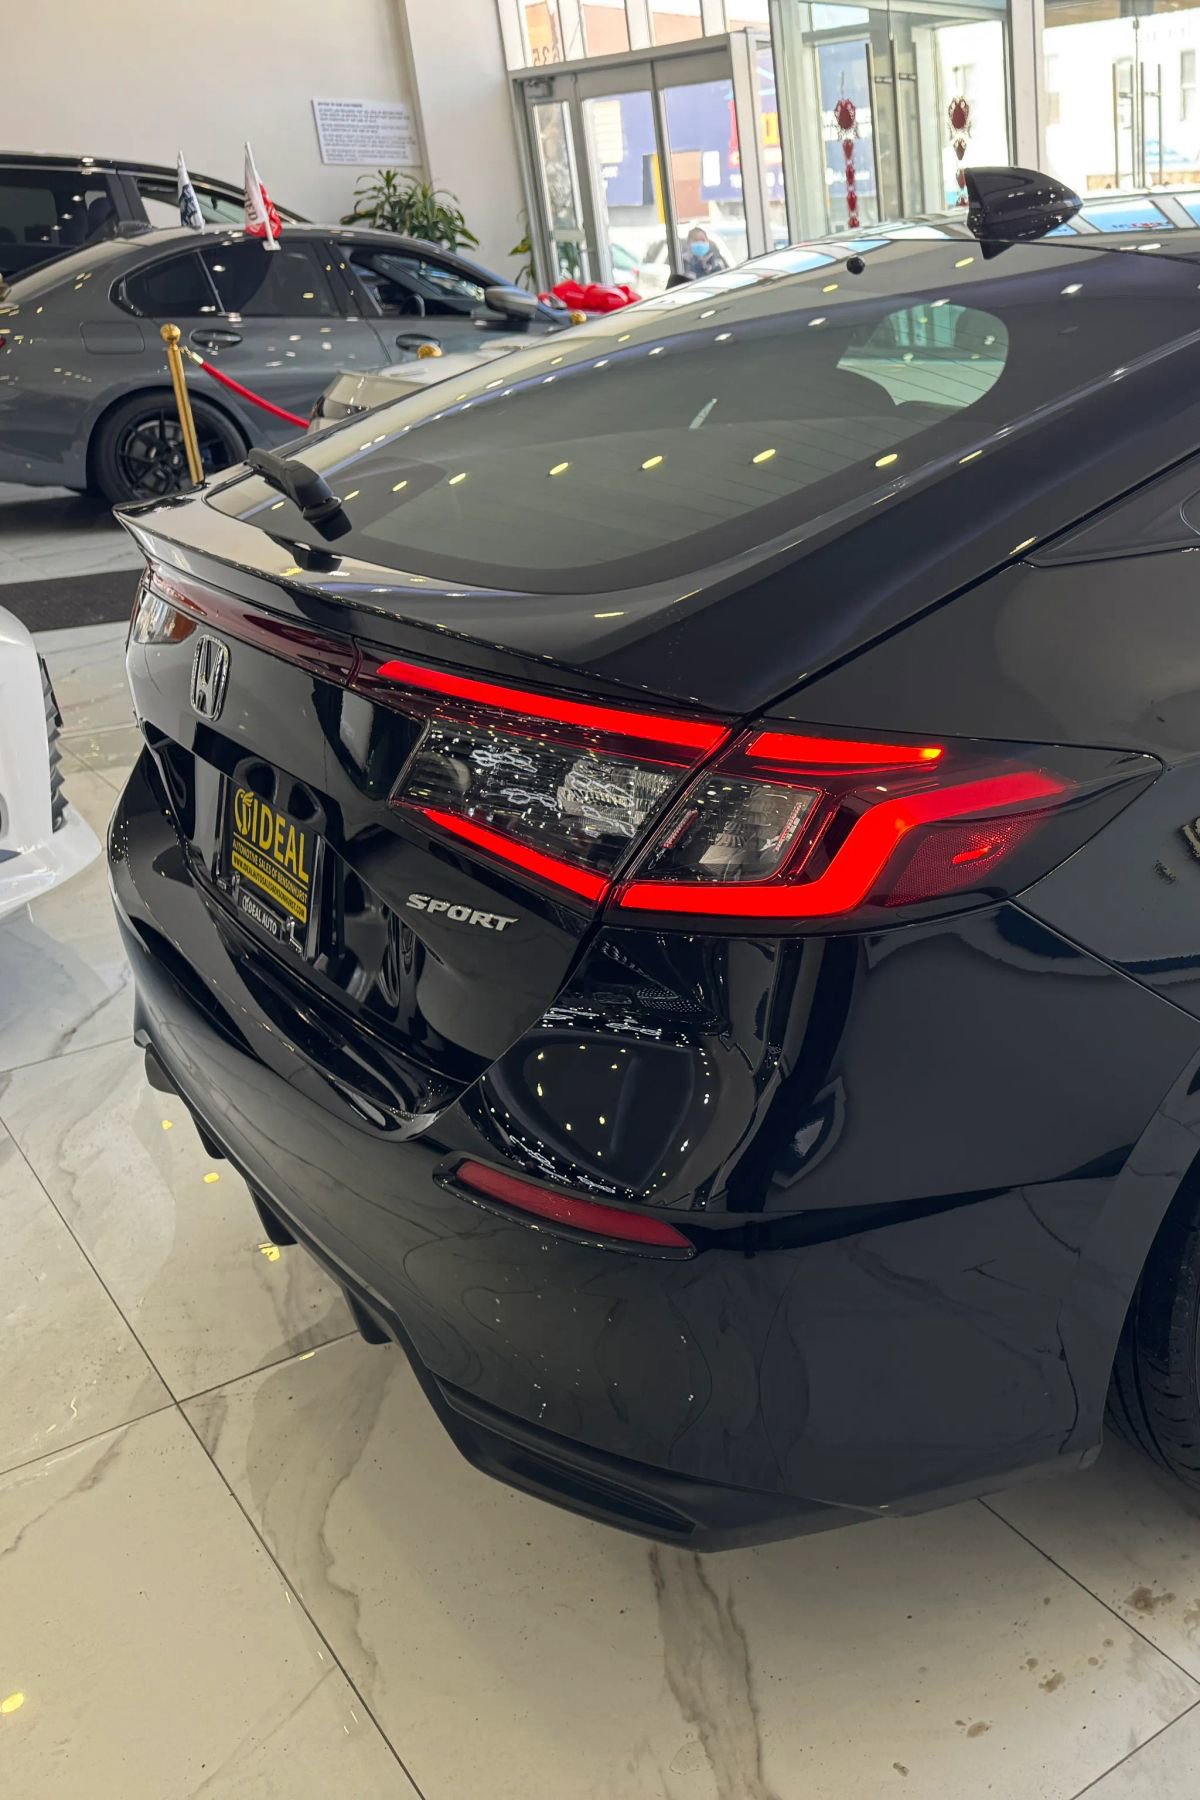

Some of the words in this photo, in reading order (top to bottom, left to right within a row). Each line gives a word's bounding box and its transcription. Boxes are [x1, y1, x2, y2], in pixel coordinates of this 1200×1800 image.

[232, 839, 259, 866] AUTOMOTIVE
[258, 858, 272, 877] SALES
[271, 867, 278, 879] OF
[252, 799, 309, 884] IDEAL
[262, 913, 277, 935] AUTO
[405, 893, 519, 931] SPORT
